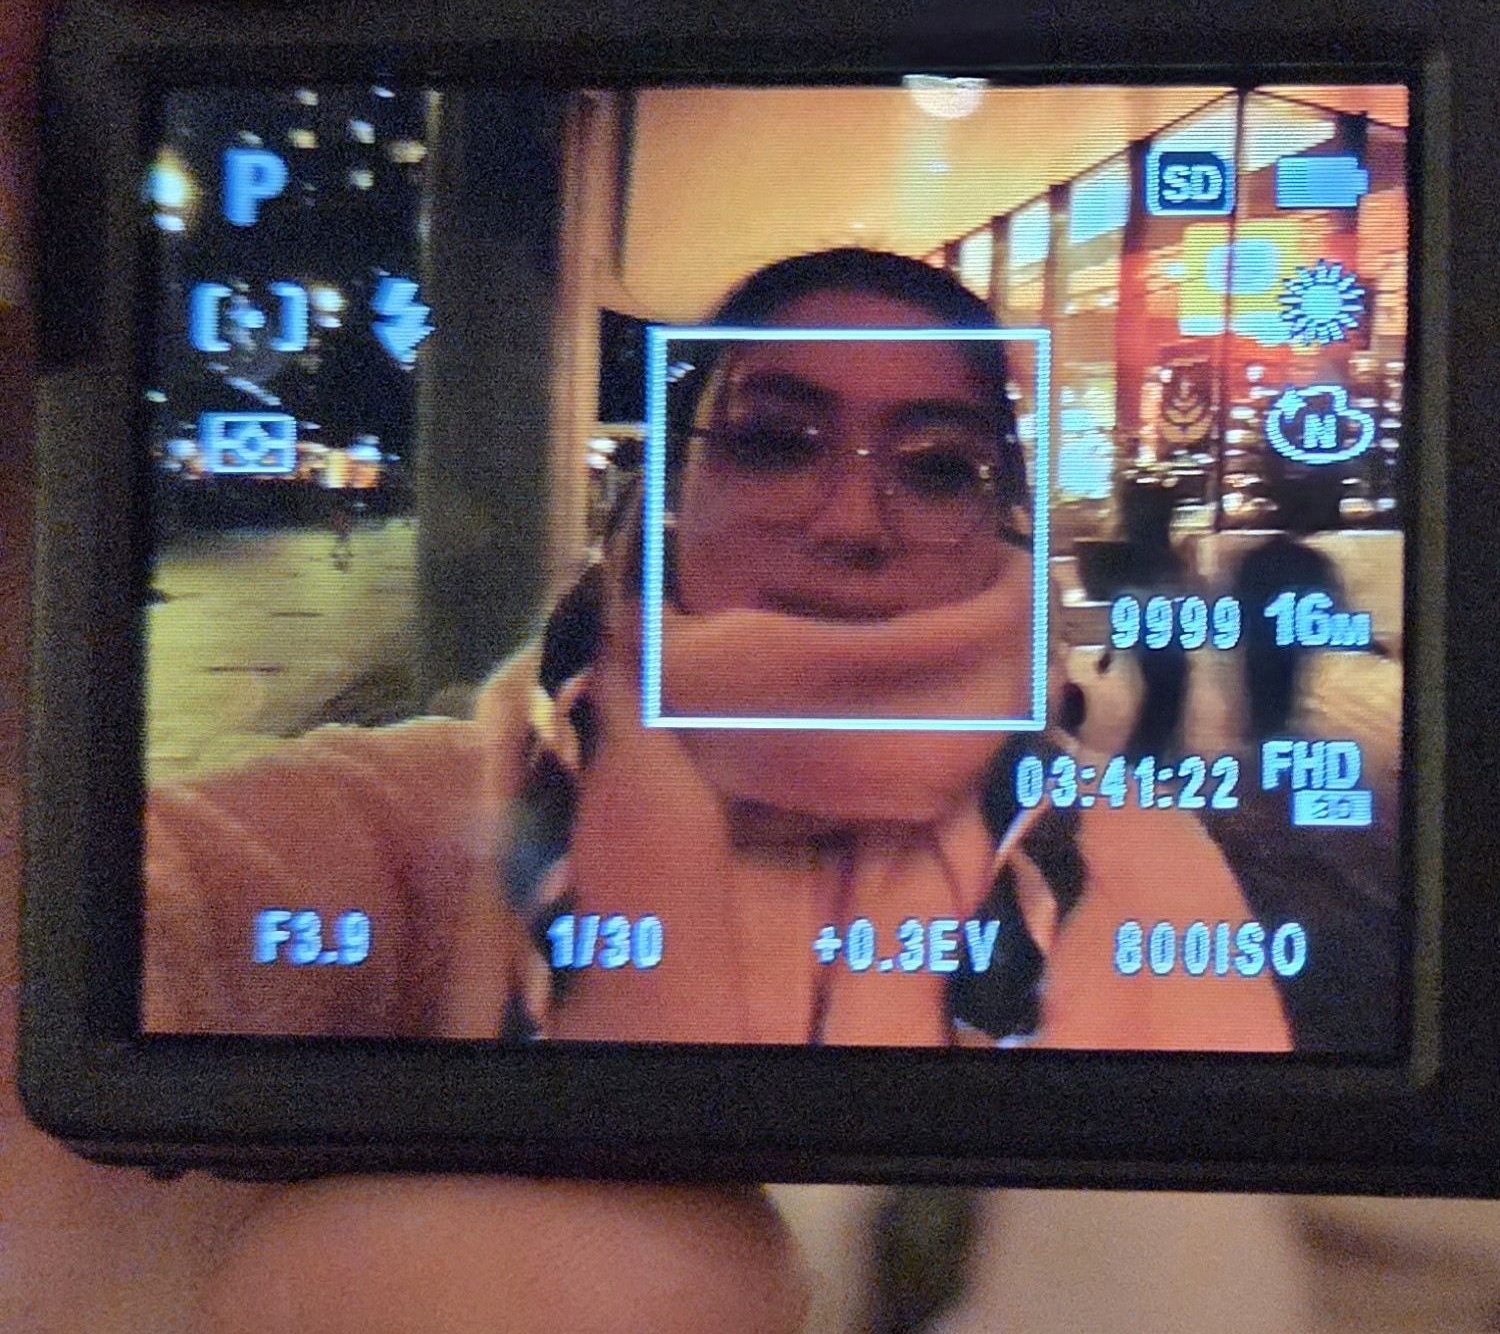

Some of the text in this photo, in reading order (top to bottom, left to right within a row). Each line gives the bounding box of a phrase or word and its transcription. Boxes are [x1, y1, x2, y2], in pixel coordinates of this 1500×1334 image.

[220, 147, 289, 227] P
[1159, 163, 1224, 203] SD
[1110, 595, 1243, 650] 9999
[1015, 754, 1241, 809] 03:41:22
[1261, 739, 1362, 790] FHD
[255, 908, 1309, 977] F3.9 1/30 +0.3EV 800ISO
